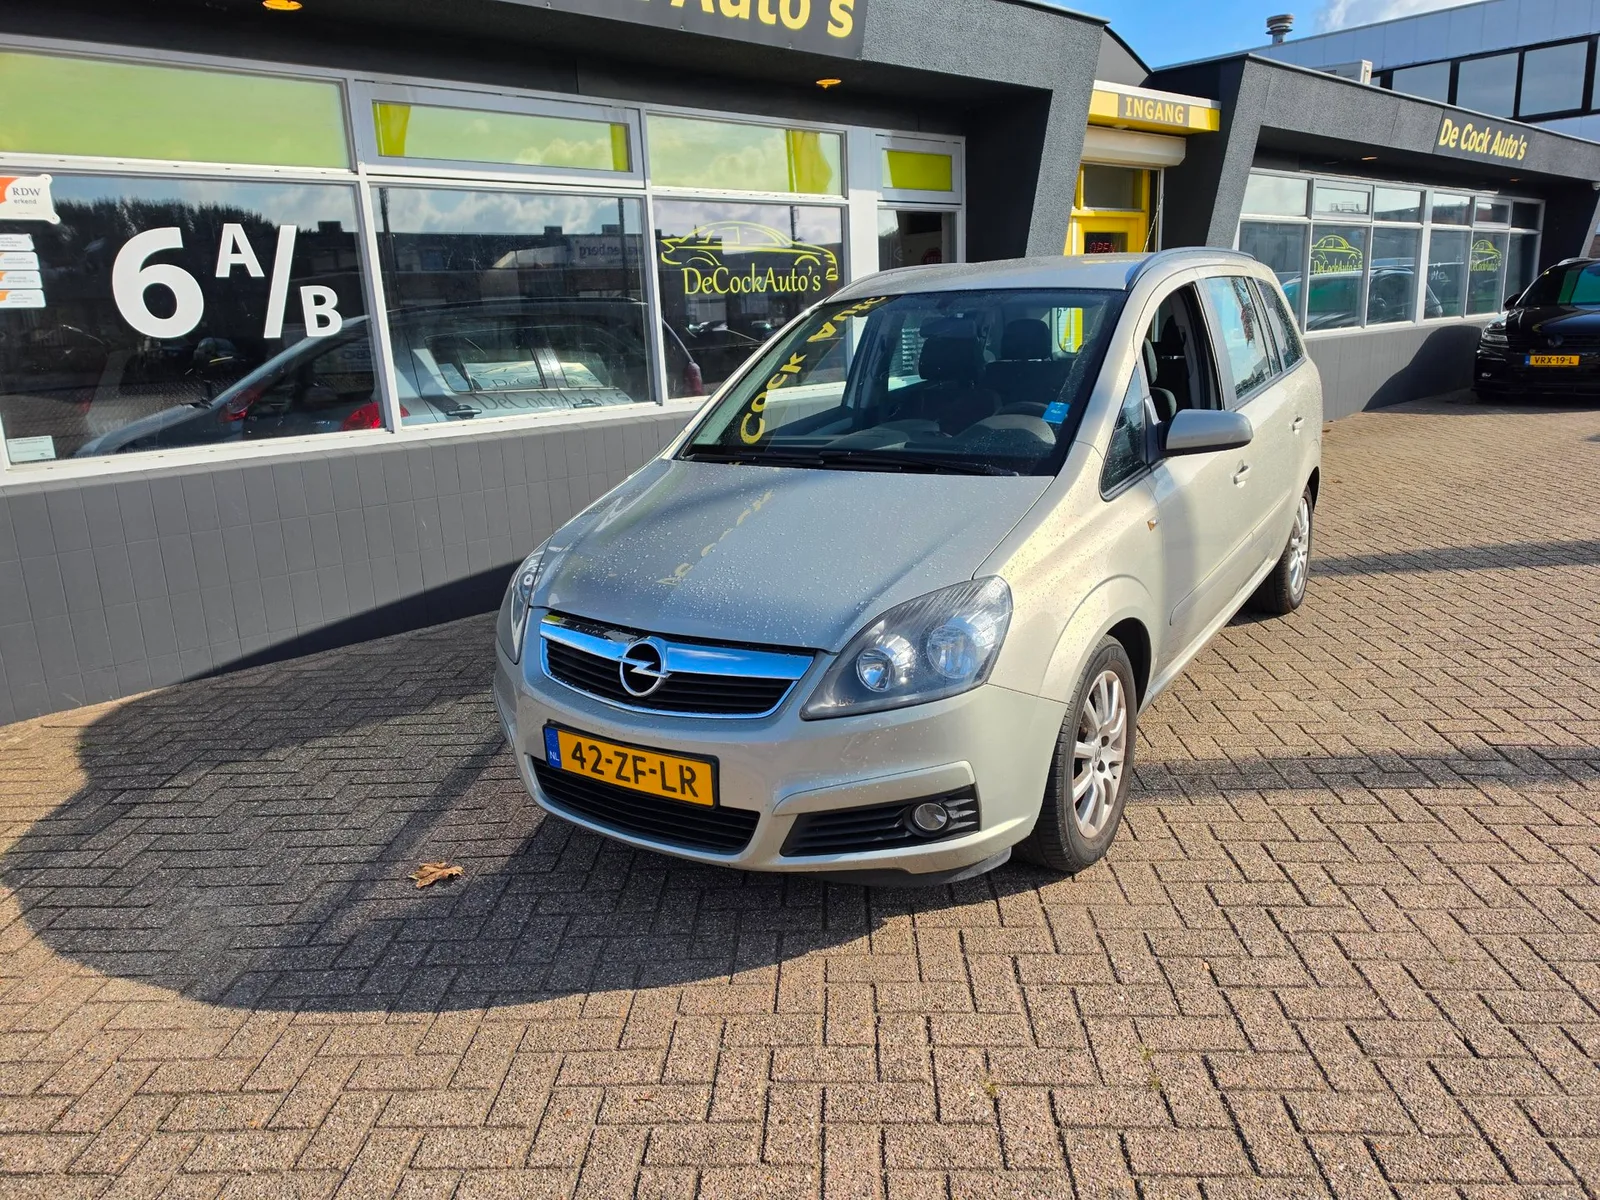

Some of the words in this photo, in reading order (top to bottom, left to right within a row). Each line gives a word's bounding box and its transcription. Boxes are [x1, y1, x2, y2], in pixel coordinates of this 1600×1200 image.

[1125, 97, 1184, 124] INGANG
[1439, 118, 1460, 148] De
[1460, 123, 1492, 153] Cock
[1489, 130, 1528, 160] Auto's
[12, 187, 41, 196] RDW
[681, 263, 821, 295] DeCockAuto's
[1533, 356, 1575, 365] VRX-19-L
[549, 750, 560, 762] NL
[571, 741, 699, 798] 42-ZF-LR
